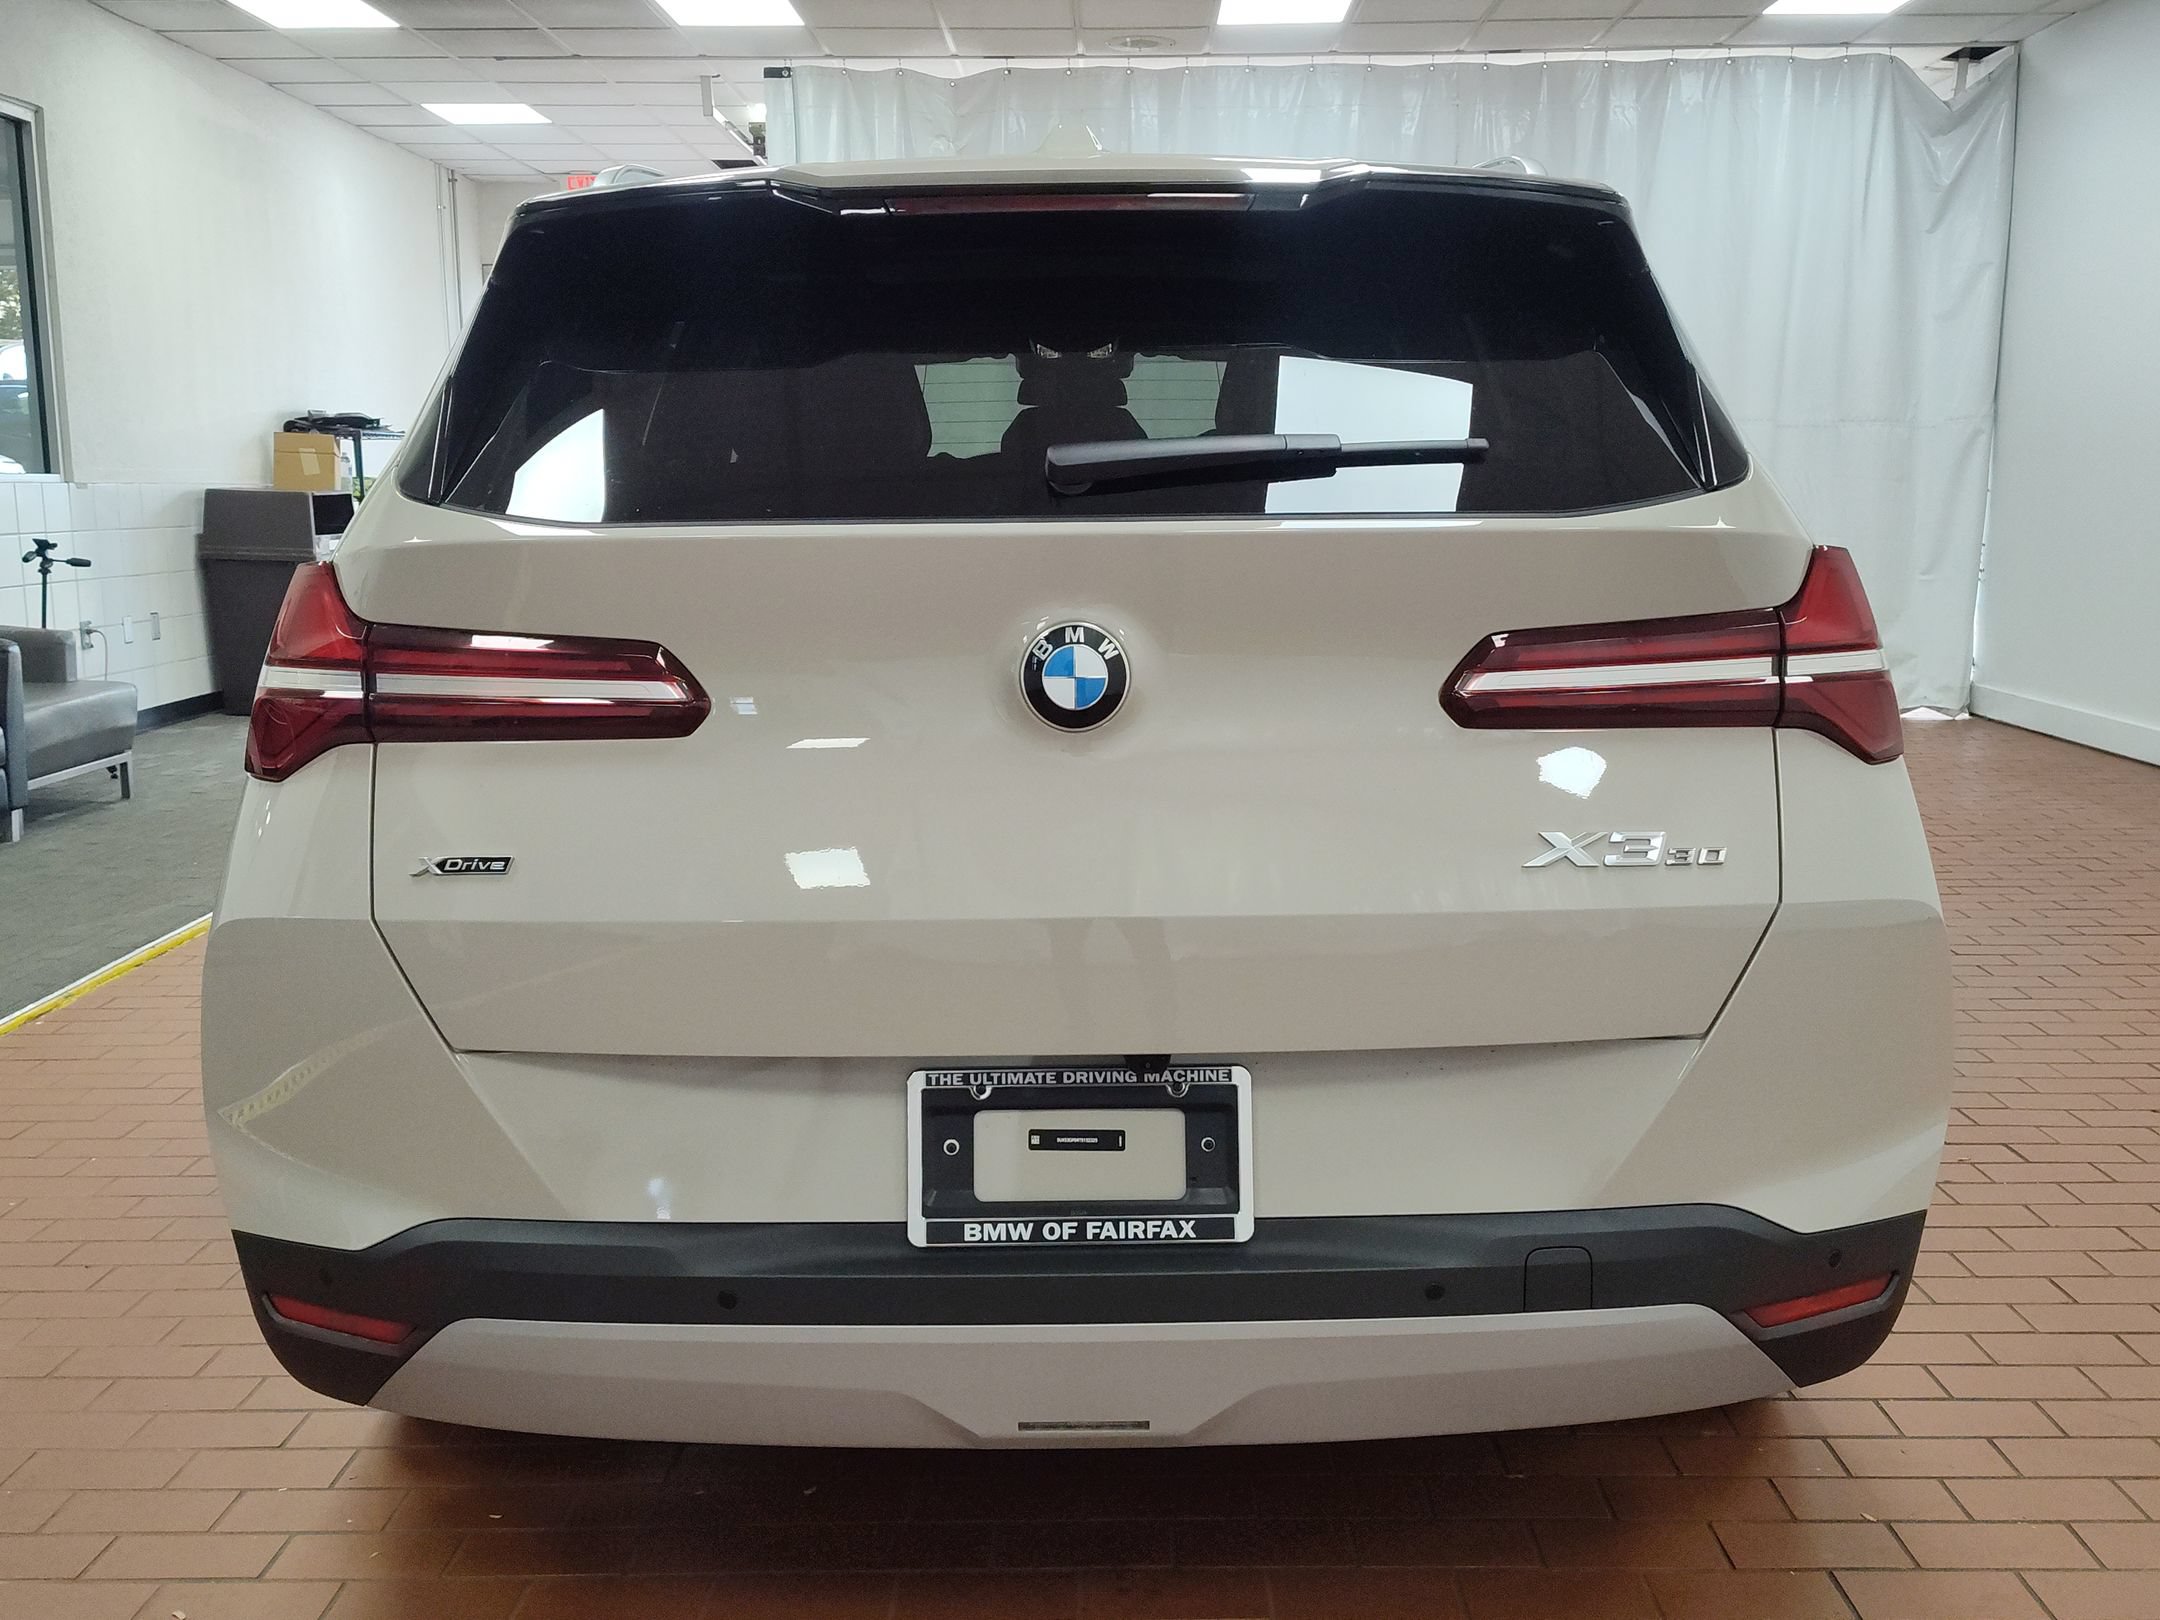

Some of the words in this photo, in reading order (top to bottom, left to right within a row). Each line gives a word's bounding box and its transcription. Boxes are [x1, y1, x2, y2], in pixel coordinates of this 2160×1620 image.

[1032, 626, 1120, 661] BMW
[928, 1073, 963, 1086] THE
[969, 1072, 1056, 1085] ULTIMATE
[1063, 1071, 1137, 1084] DRIVING
[1144, 1069, 1230, 1083] MACHINE
[963, 1222, 1034, 1242] BMW
[1042, 1222, 1078, 1241] OF
[1086, 1220, 1197, 1240] FAIRFAX
